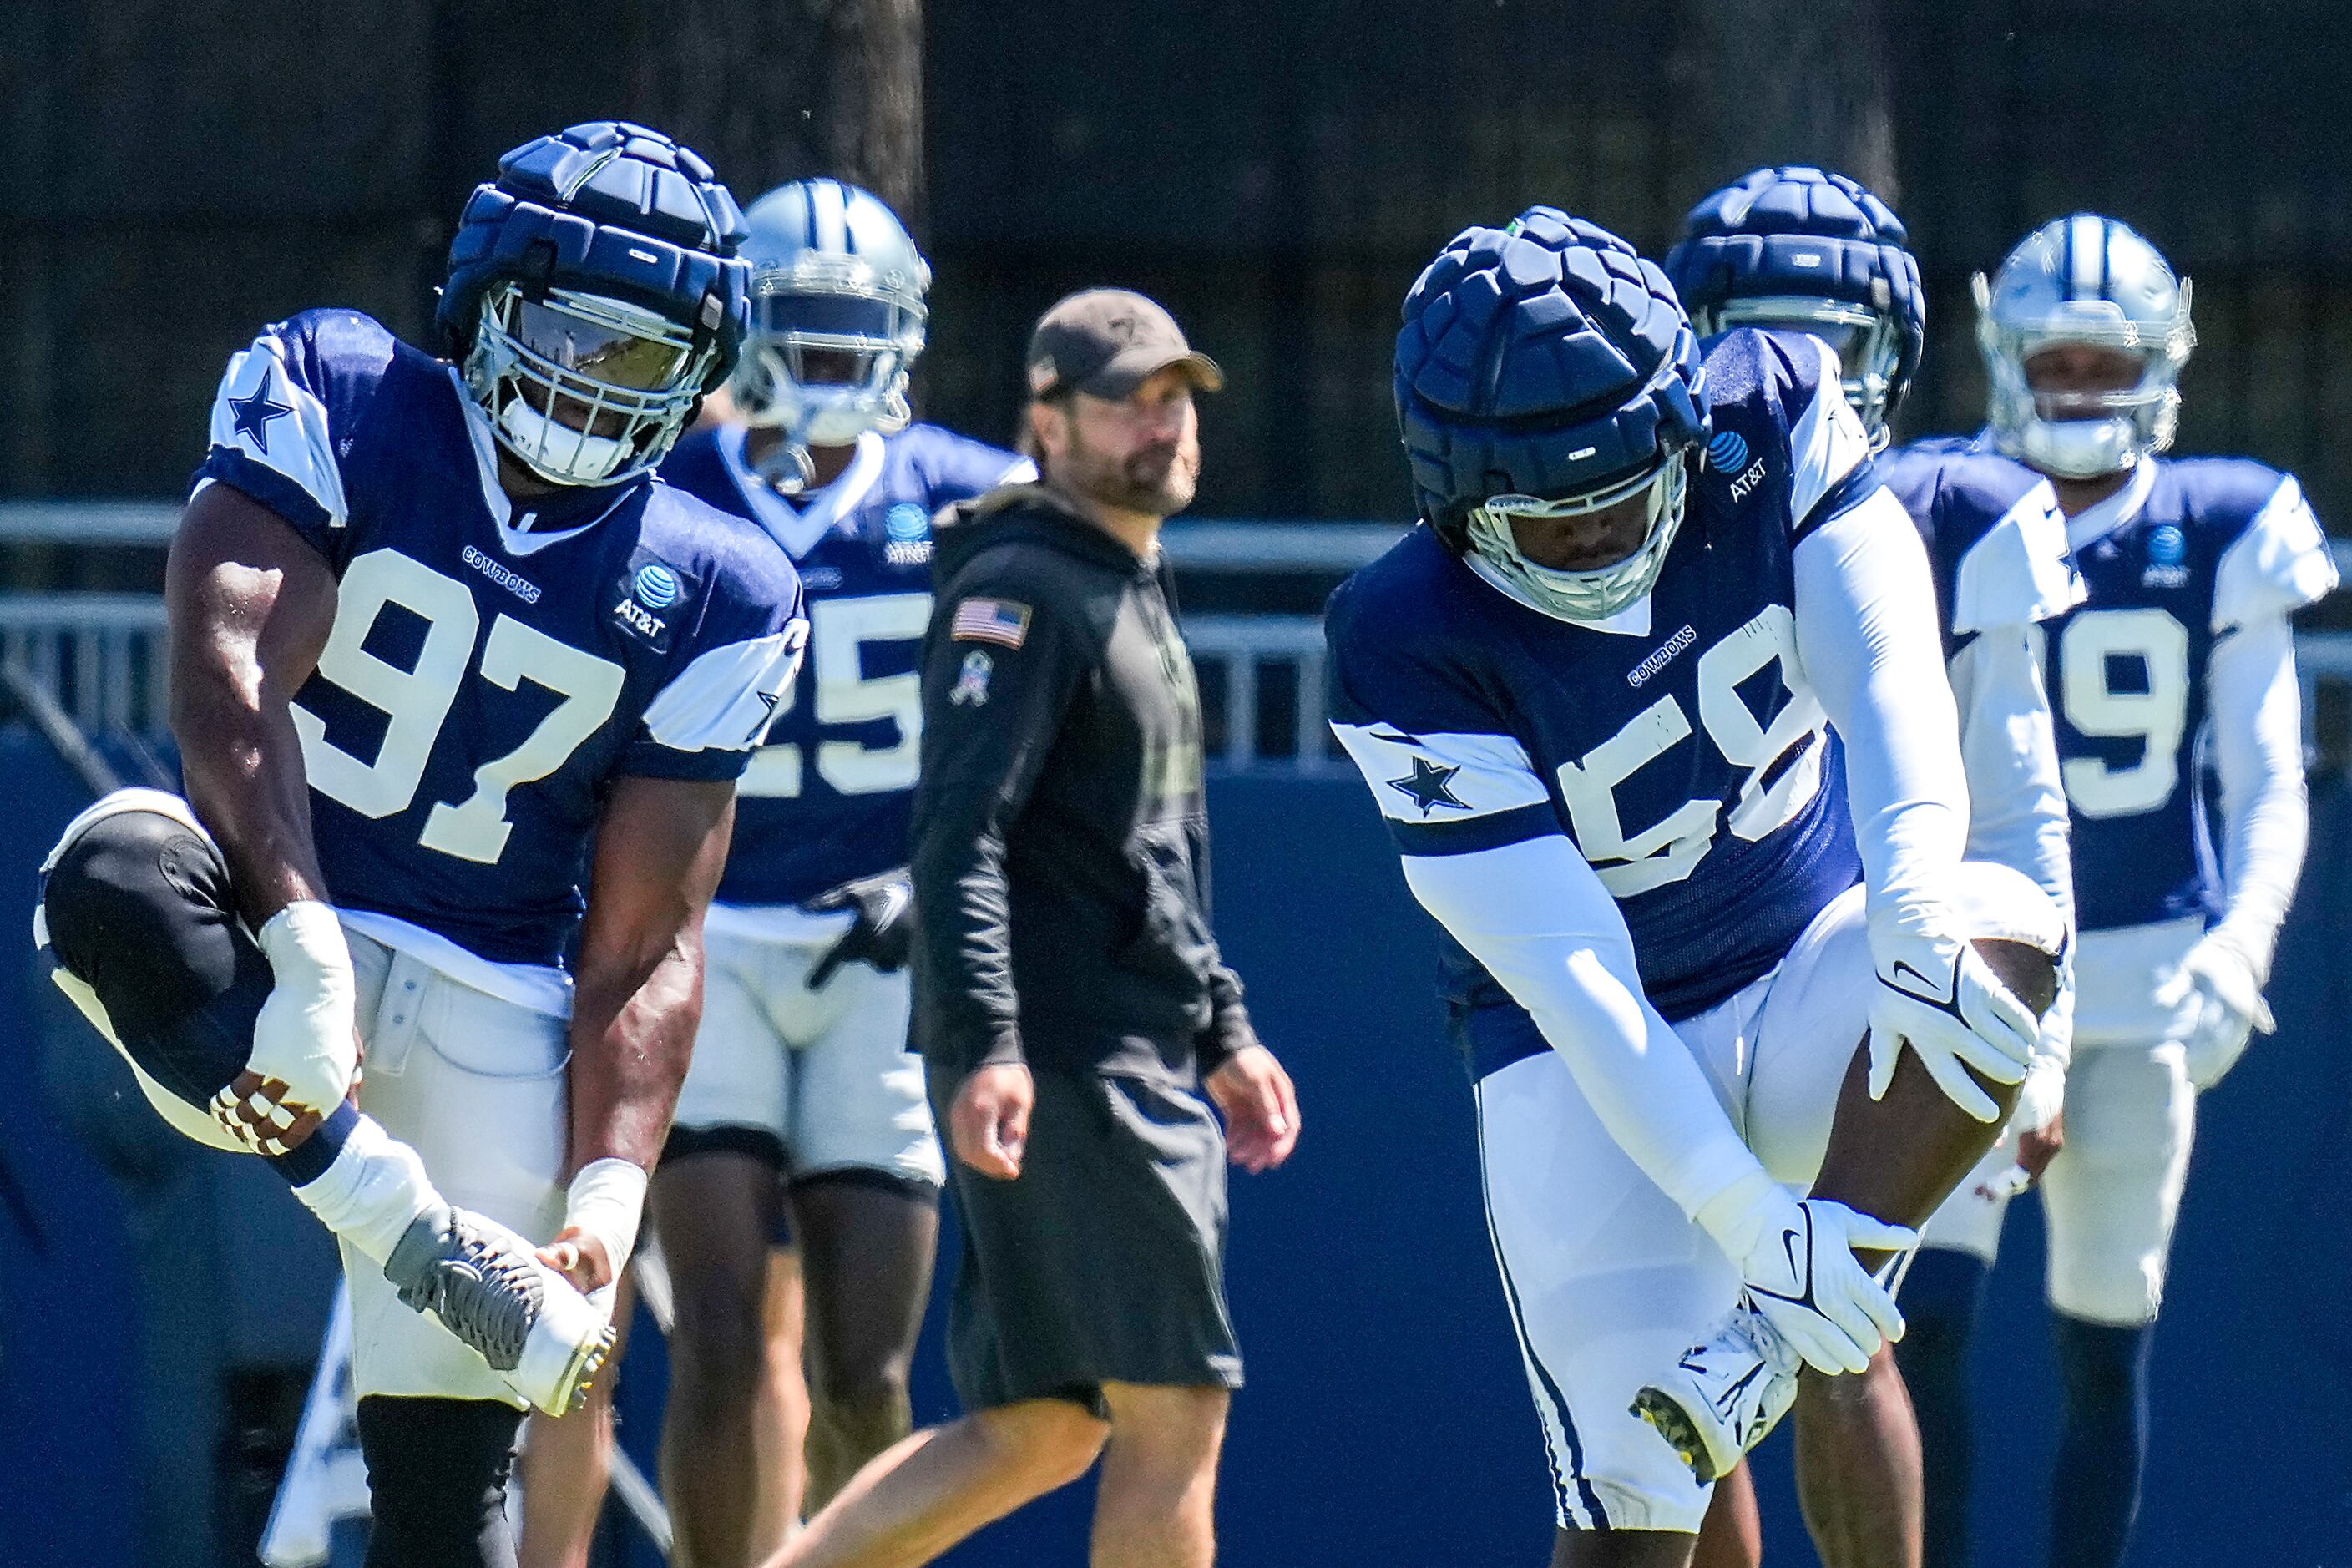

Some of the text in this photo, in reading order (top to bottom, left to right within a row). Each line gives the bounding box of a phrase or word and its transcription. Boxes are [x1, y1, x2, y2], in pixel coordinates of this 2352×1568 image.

[1729, 456, 1765, 504] AT&T
[463, 544, 542, 604] COWBOYS
[613, 598, 666, 638] AT&T
[289, 547, 627, 865] 97
[735, 591, 935, 799] 5
[1626, 624, 1697, 688] COWBOYS
[2026, 607, 2191, 821] 9
[1556, 603, 1828, 899] 58
